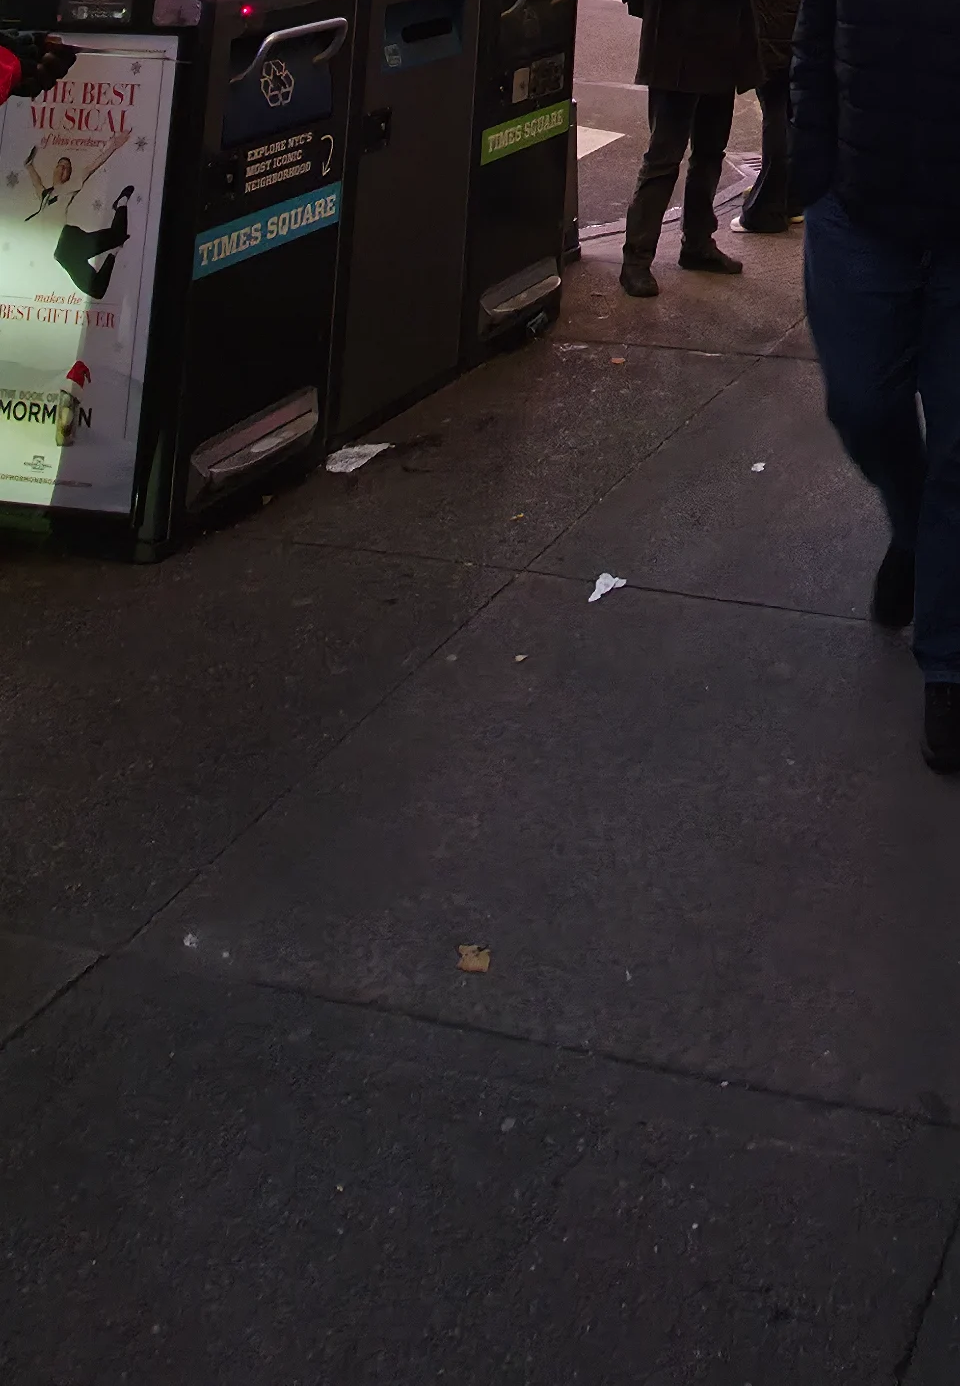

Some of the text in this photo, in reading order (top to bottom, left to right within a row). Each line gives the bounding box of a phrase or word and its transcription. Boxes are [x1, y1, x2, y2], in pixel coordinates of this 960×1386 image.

[82, 81, 141, 107] BEST
[29, 105, 134, 133] MUSICAL
[487, 108, 565, 154] TIMES SQUARE
[40, 133, 53, 150] of
[53, 133, 70, 146] this
[247, 131, 313, 162] EXPLORE NYC'S
[244, 161, 312, 194] NEIGHBORHOOD
[245, 149, 302, 178] MOST ICONIC
[198, 193, 337, 266] TIMES SQUARE
[34, 292, 83, 306] makes the
[0, 303, 116, 330] BEST GIFT EVER
[0, 399, 93, 429] MORMN
